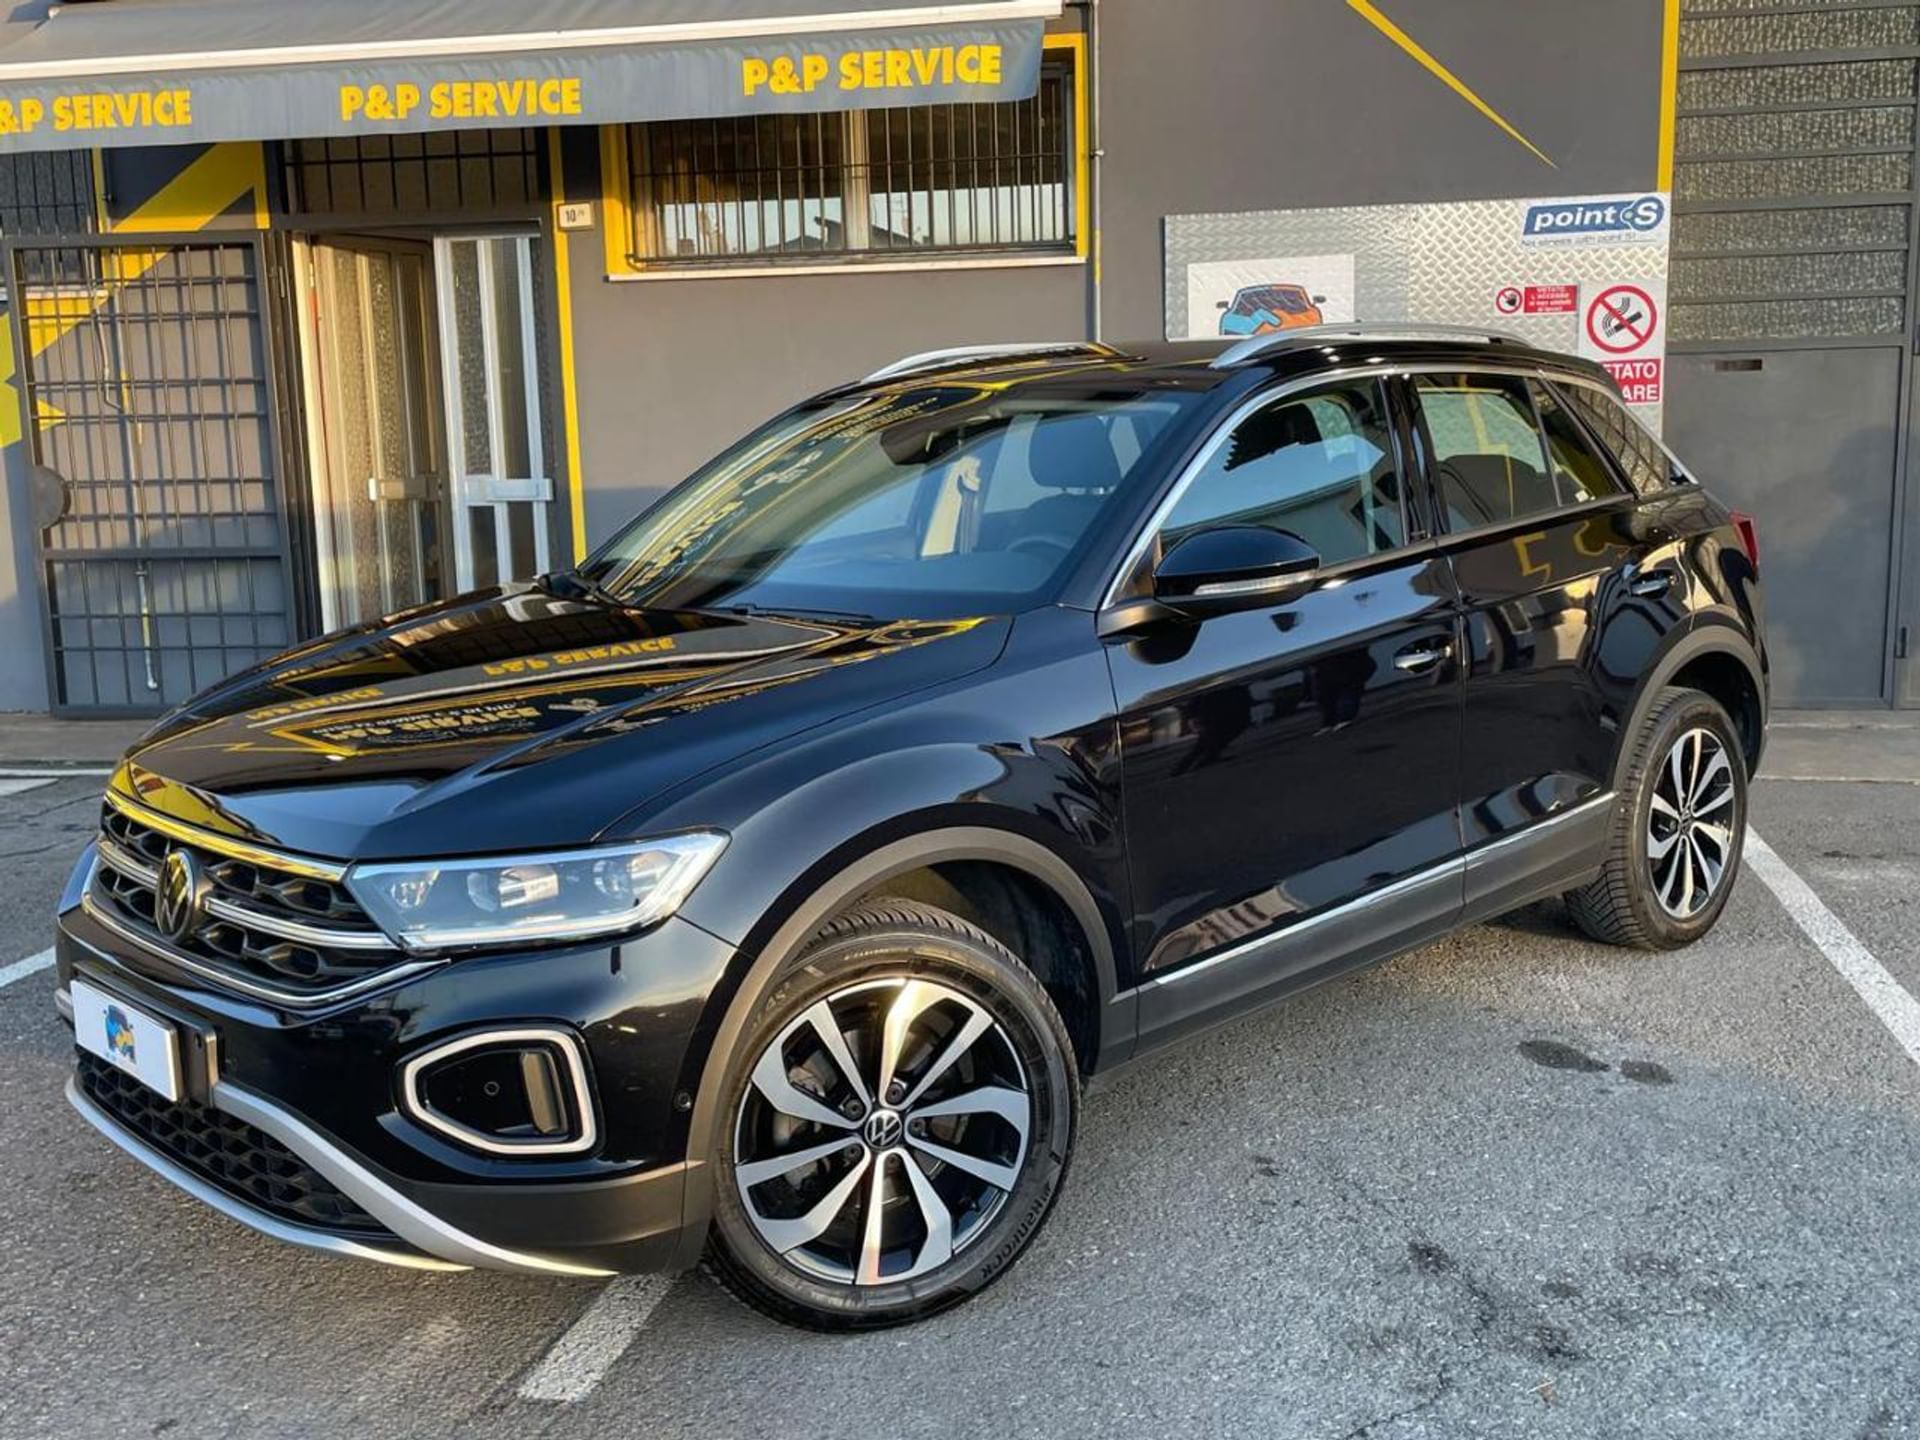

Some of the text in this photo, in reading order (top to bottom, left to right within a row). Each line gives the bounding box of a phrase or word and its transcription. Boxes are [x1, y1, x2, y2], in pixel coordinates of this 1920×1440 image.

[742, 44, 1002, 96] P&P SERVICE
[52, 90, 193, 132] SERVICE
[339, 78, 583, 121] P&P SERVICE
[1533, 201, 1659, 232] point S
[1622, 384, 1658, 400] ARE
